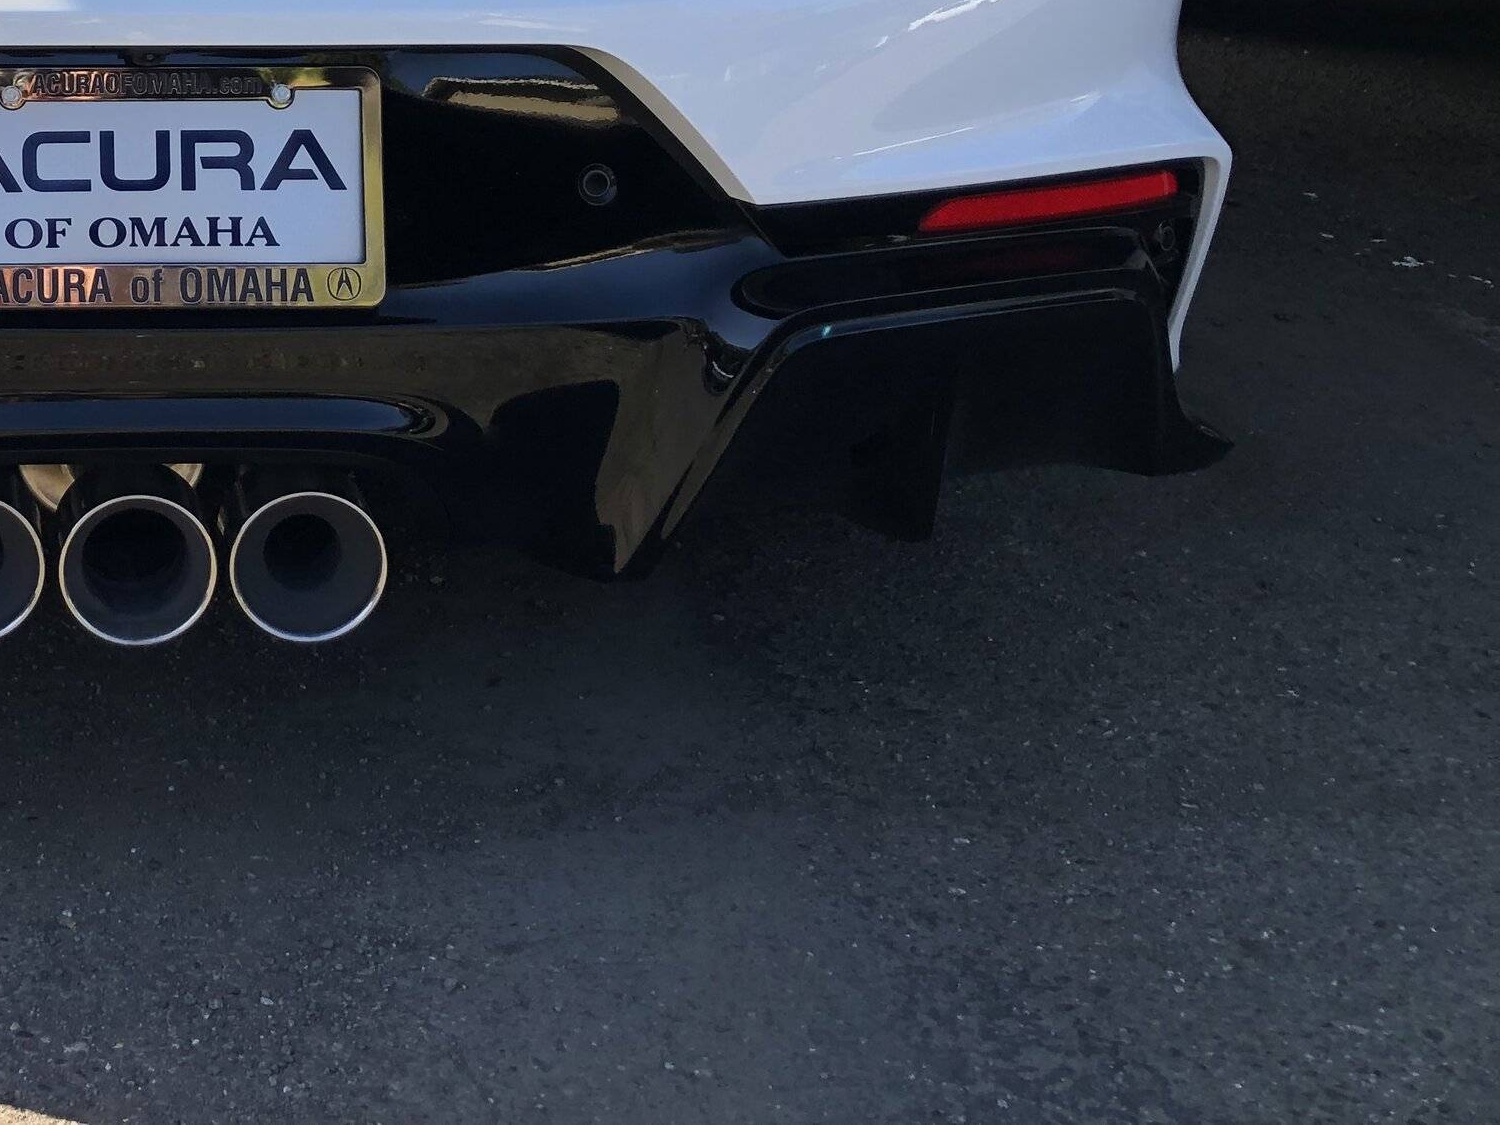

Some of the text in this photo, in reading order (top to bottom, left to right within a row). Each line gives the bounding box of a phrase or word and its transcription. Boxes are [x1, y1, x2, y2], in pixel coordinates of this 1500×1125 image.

[4, 216, 281, 248] OF OMAHA
[131, 270, 163, 303] of
[179, 268, 315, 303] OMAHA
